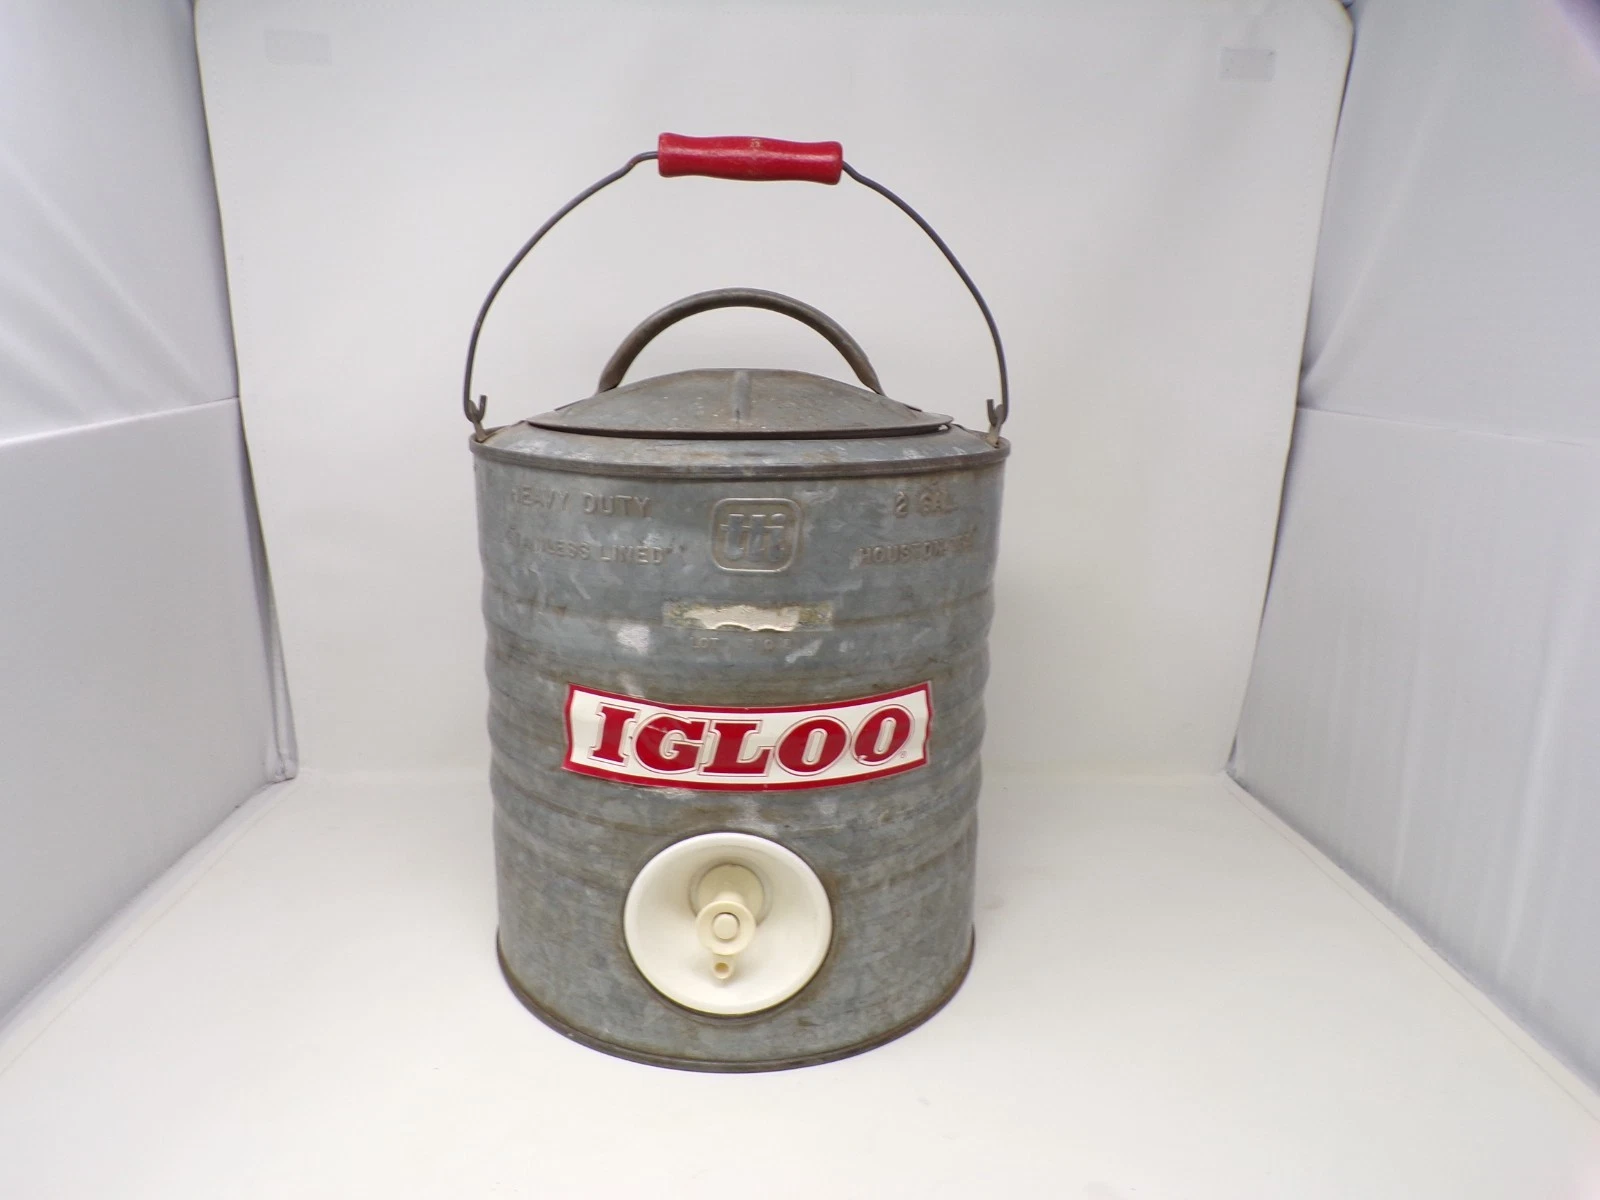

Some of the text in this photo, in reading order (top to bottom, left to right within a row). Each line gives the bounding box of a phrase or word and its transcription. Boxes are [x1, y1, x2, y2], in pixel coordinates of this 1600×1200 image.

[582, 491, 651, 518] DUTY
[894, 489, 909, 519] 2
[589, 703, 915, 776] IGLOO
